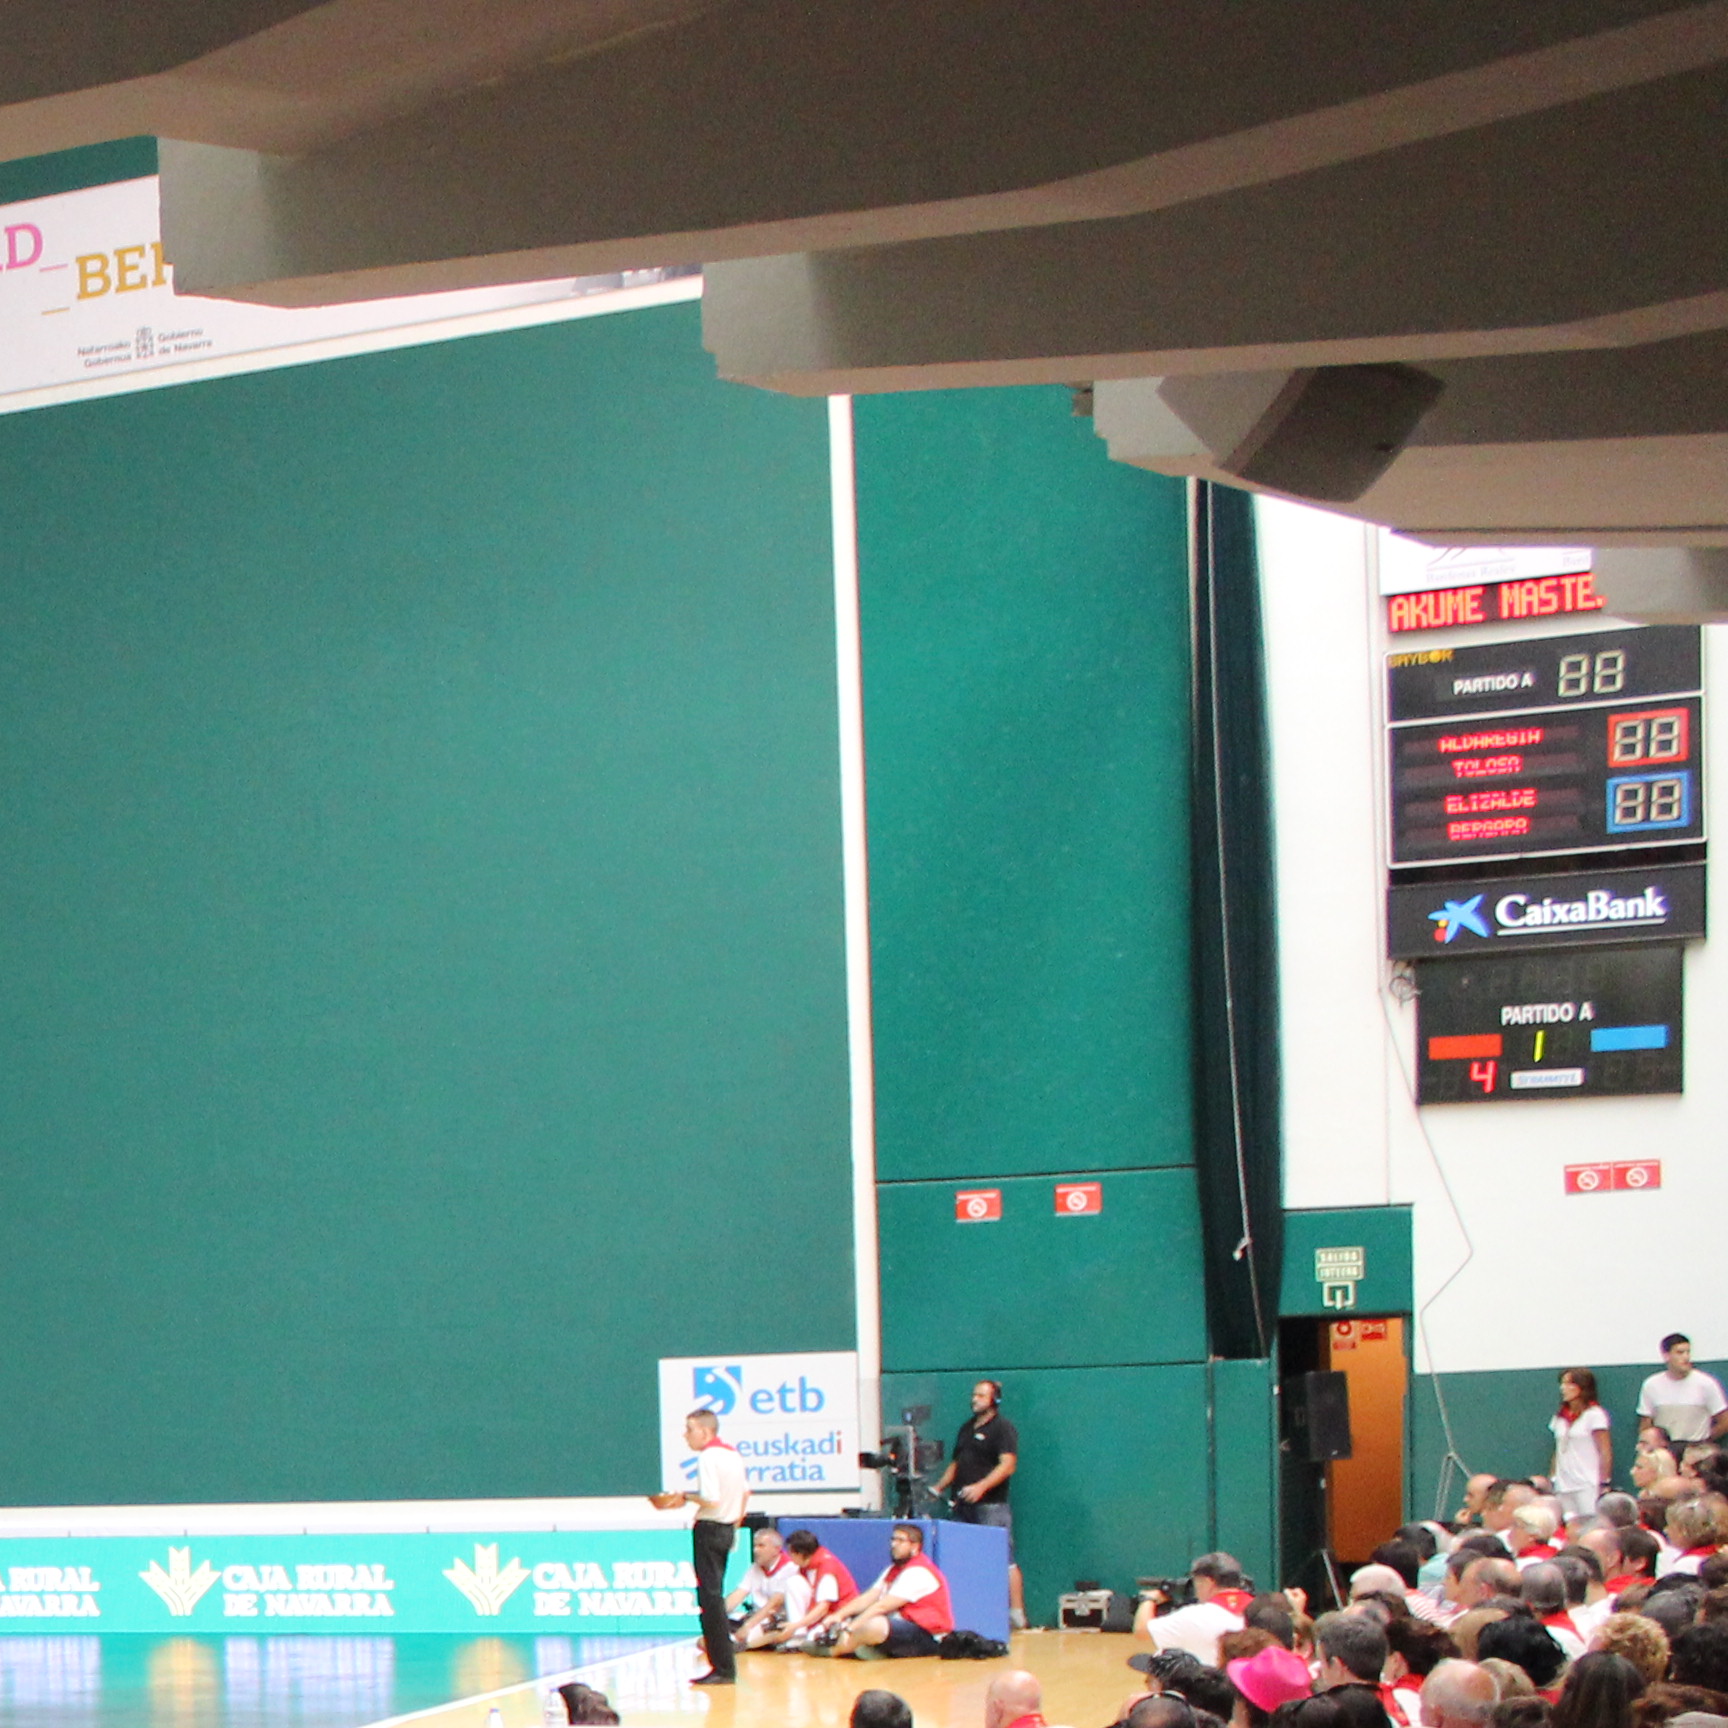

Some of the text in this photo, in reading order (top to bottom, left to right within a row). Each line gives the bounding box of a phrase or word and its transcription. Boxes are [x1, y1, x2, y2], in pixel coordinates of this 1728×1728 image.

[1388, 571, 1607, 633] AKUME MASTE
[1453, 672, 1534, 696] PARTIDO A
[1494, 885, 1668, 928] CaixaBank
[1501, 1001, 1594, 1026] PARTIDO A
[1469, 1059, 1496, 1094] 4
[749, 1375, 826, 1415] etb
[735, 1430, 843, 1457] euskadi
[744, 1457, 825, 1483] rratia
[9, 1566, 101, 1593] RURAL
[222, 1564, 395, 1592] CAJA RURAL
[532, 1561, 699, 1591] CAJA RURA
[223, 1593, 395, 1618] DE NAVARRA
[533, 1591, 703, 1617] DE NAVARR
